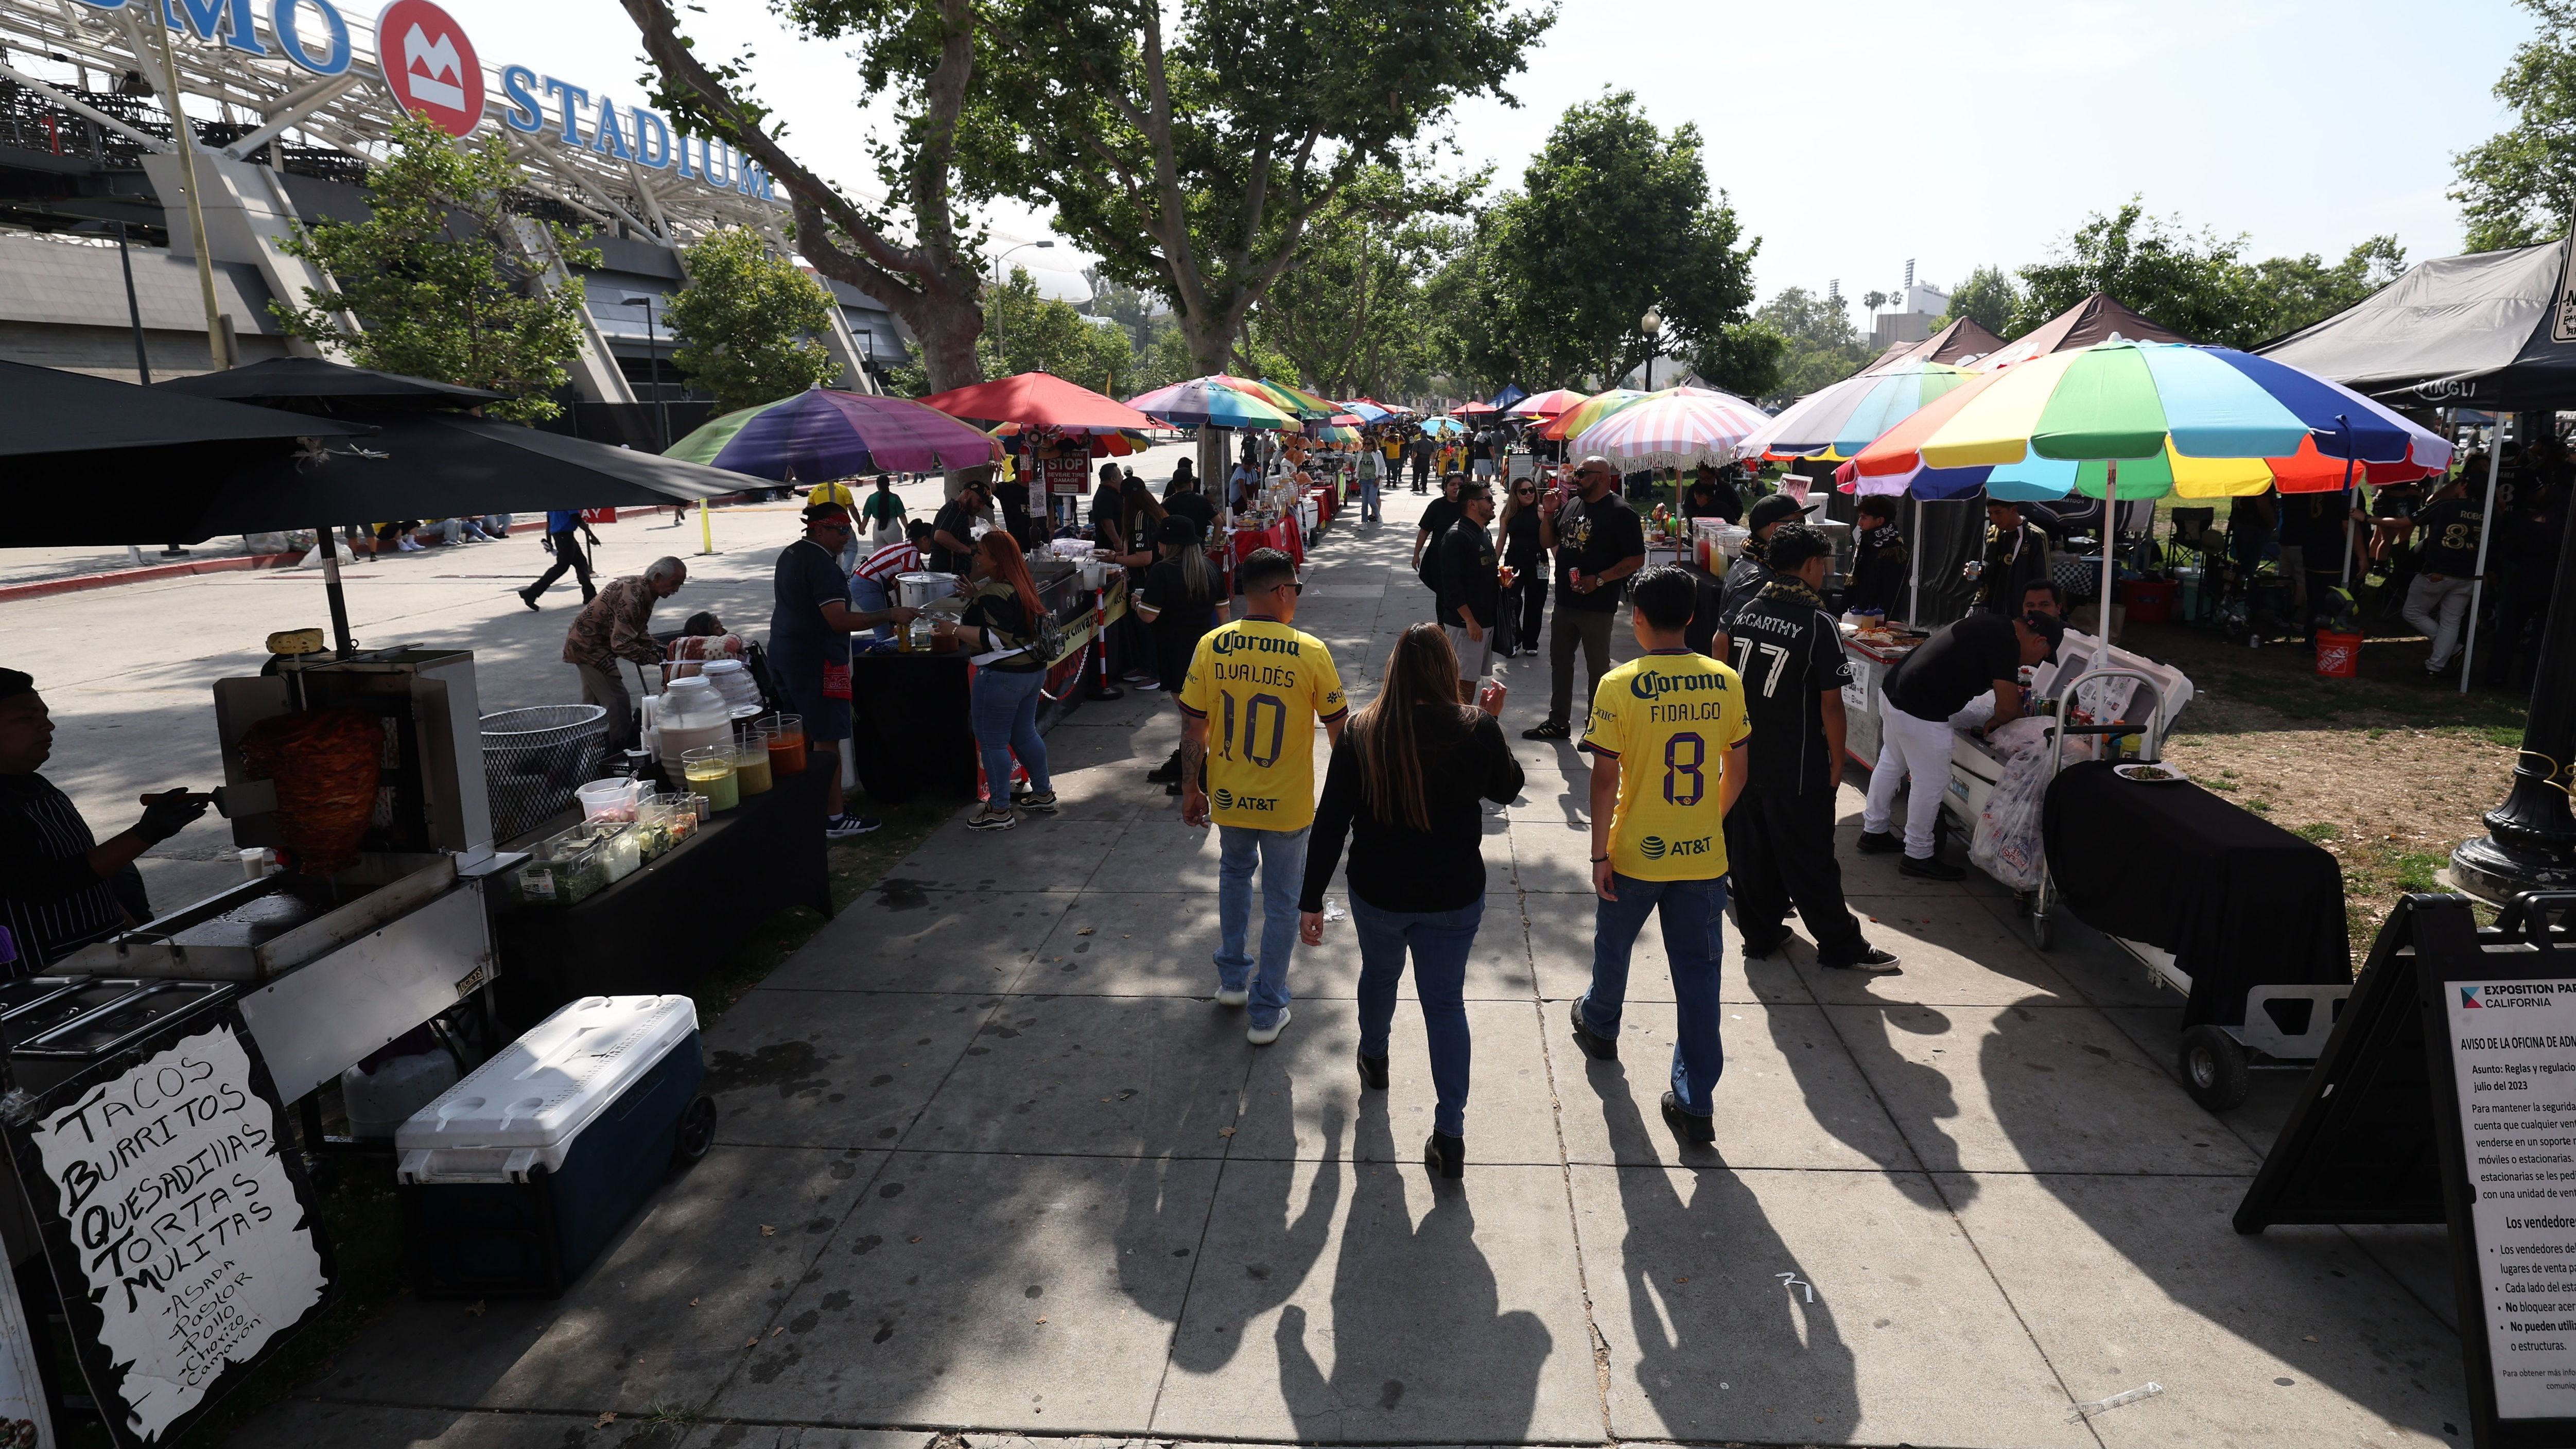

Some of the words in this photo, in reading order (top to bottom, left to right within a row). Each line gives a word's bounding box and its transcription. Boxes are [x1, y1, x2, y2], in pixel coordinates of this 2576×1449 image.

[80, 0, 352, 77] MO
[500, 64, 774, 201] STADIUM
[1048, 458, 1083, 470] STOP
[581, 508, 601, 518] AY
[1212, 630, 1300, 658] Corona
[1734, 637, 1790, 698] 77
[1631, 670, 1728, 701] Corona
[1650, 702, 1720, 723] FIDALGO
[1219, 689, 1286, 768] 10
[1663, 732, 1704, 807] 8
[1237, 796, 1277, 811] AT&T
[1670, 837, 1711, 856] AT&T
[2484, 984, 2553, 994] EXPOSITION
[2486, 998, 2551, 1008] CALIFORNIA
[2461, 1038, 2485, 1050] AVISO
[2487, 1038, 2498, 1049] DE
[2500, 1037, 2510, 1049] LA
[2512, 1036, 2545, 1049] OFICINA
[2547, 1036, 2557, 1048] DE
[2472, 1065, 2503, 1074] Asunto:
[2505, 1063, 2531, 1075] Reglas
[2533, 1066, 2537, 1074] y
[2474, 1082, 2492, 1093] julio
[2494, 1081, 2506, 1090] del
[2508, 1081, 2528, 1090] 2023
[55, 1057, 213, 1143] TACOS
[2472, 1104, 2490, 1113] Para
[2492, 1104, 2531, 1112] mantener
[2533, 1103, 2540, 1111] la
[2475, 1122, 2501, 1130] cuenta
[2503, 1122, 2519, 1131] que
[2521, 1120, 2558, 1130] cualquier
[2476, 1138, 2513, 1147] venderse
[2540, 1137, 2571, 1147] soporte
[61, 1083, 246, 1217] BURRITOS
[2479, 1155, 2510, 1164] móviles
[2519, 1154, 2574, 1163] estacionarias.
[2481, 1172, 2533, 1181] estacionarias
[2546, 1171, 2558, 1180] les
[2517, 1189, 2545, 1198] unidad
[2547, 1188, 2557, 1197] de
[92, 1174, 259, 1277] TORTAS
[2506, 1216, 2522, 1229] Los
[2500, 1245, 2514, 1254] Los
[2516, 1243, 2563, 1254] vendedores
[123, 1201, 272, 1313] MULITAS
[2500, 1263, 2530, 1276] lugares
[2532, 1263, 2542, 1273] de
[2544, 1263, 2567, 1273] venta
[172, 1260, 235, 1318] ASADA
[2505, 1282, 2526, 1293] Cada
[2527, 1282, 2545, 1293] lado
[2547, 1281, 2560, 1292] del
[2505, 1302, 2518, 1312] No
[2519, 1301, 2556, 1314] bloquear
[2511, 1321, 2522, 1332] No
[2525, 1321, 2556, 1334] pueden
[2511, 1343, 2516, 1351] o
[2518, 1341, 2567, 1351] estructuras.
[2519, 1368, 2545, 1376] obtener
